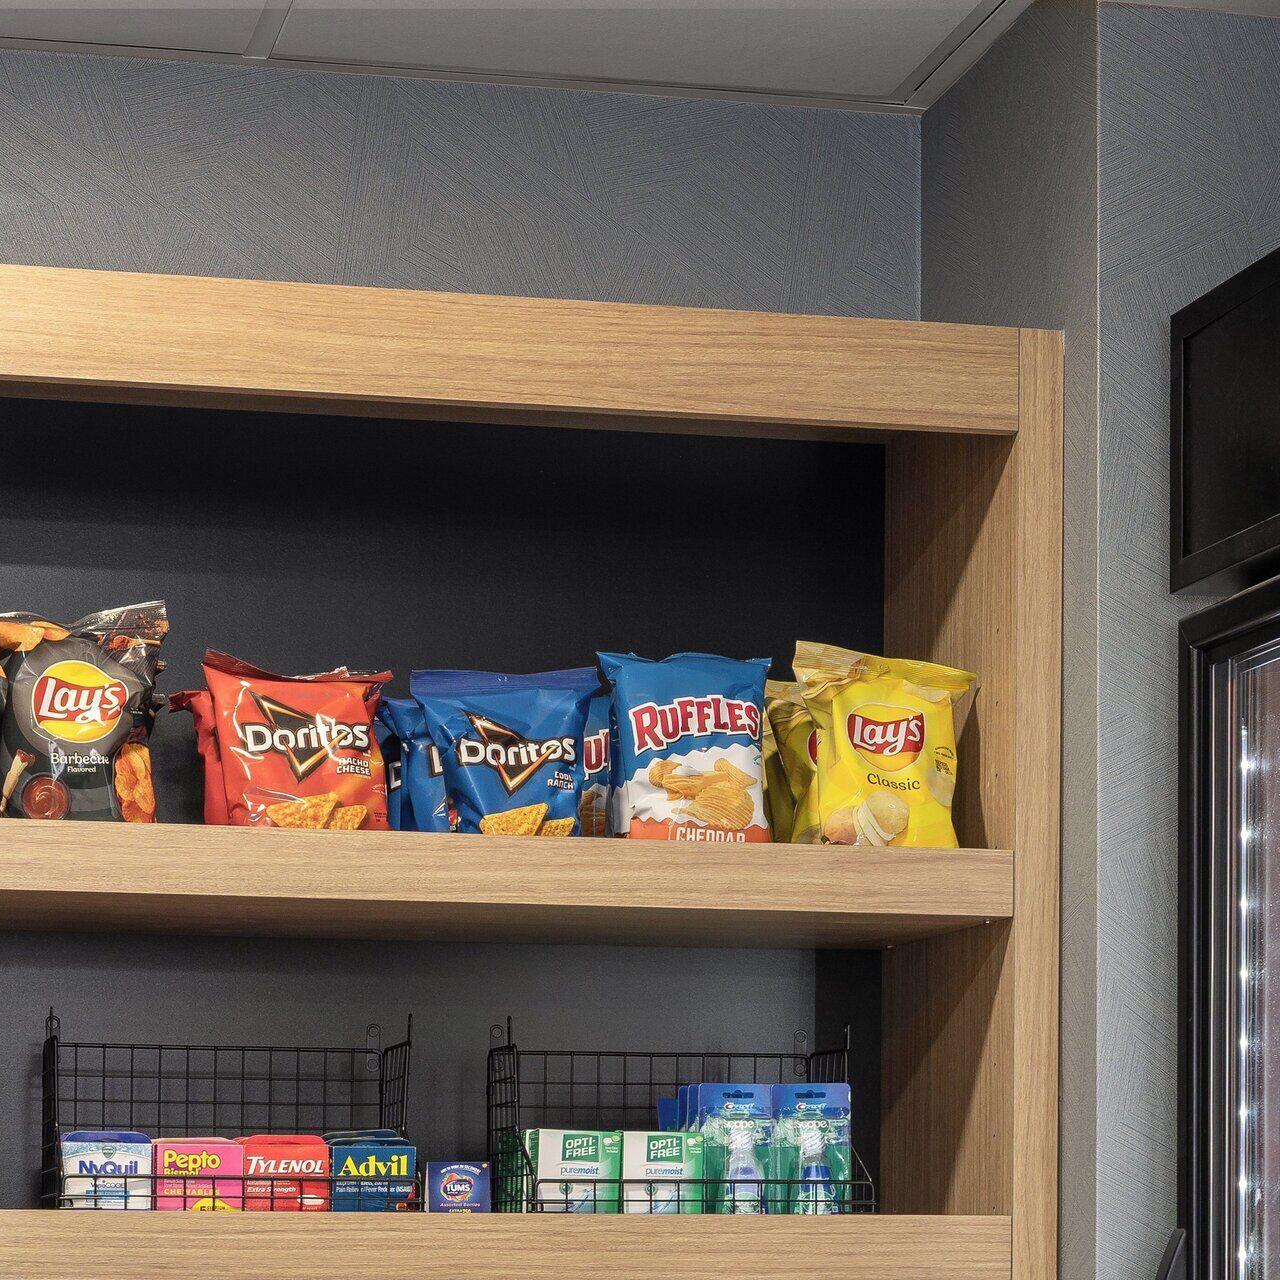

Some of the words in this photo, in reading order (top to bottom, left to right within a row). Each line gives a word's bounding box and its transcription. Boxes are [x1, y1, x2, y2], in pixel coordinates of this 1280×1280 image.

[39, 678, 121, 724] Lay's
[633, 698, 760, 751] RUFFLES
[244, 725, 368, 751] Doritos
[854, 714, 923, 756] Lay's
[50, 753, 109, 765] Barbecue
[460, 739, 575, 765] Doritos
[337, 766, 370, 775] CHEESE
[547, 779, 574, 789] RANCH
[867, 773, 920, 790] Classic
[565, 1139, 597, 1149] OPTI-
[650, 1139, 680, 1149] OPTI-
[566, 1147, 596, 1158] FREE
[650, 1147, 680, 1158] FREE
[163, 1150, 221, 1171] Pepto
[247, 1157, 323, 1174] TYLENOL
[338, 1155, 408, 1177] Advil
[560, 1166, 600, 1177] puremoist
[646, 1166, 684, 1177] puremoist
